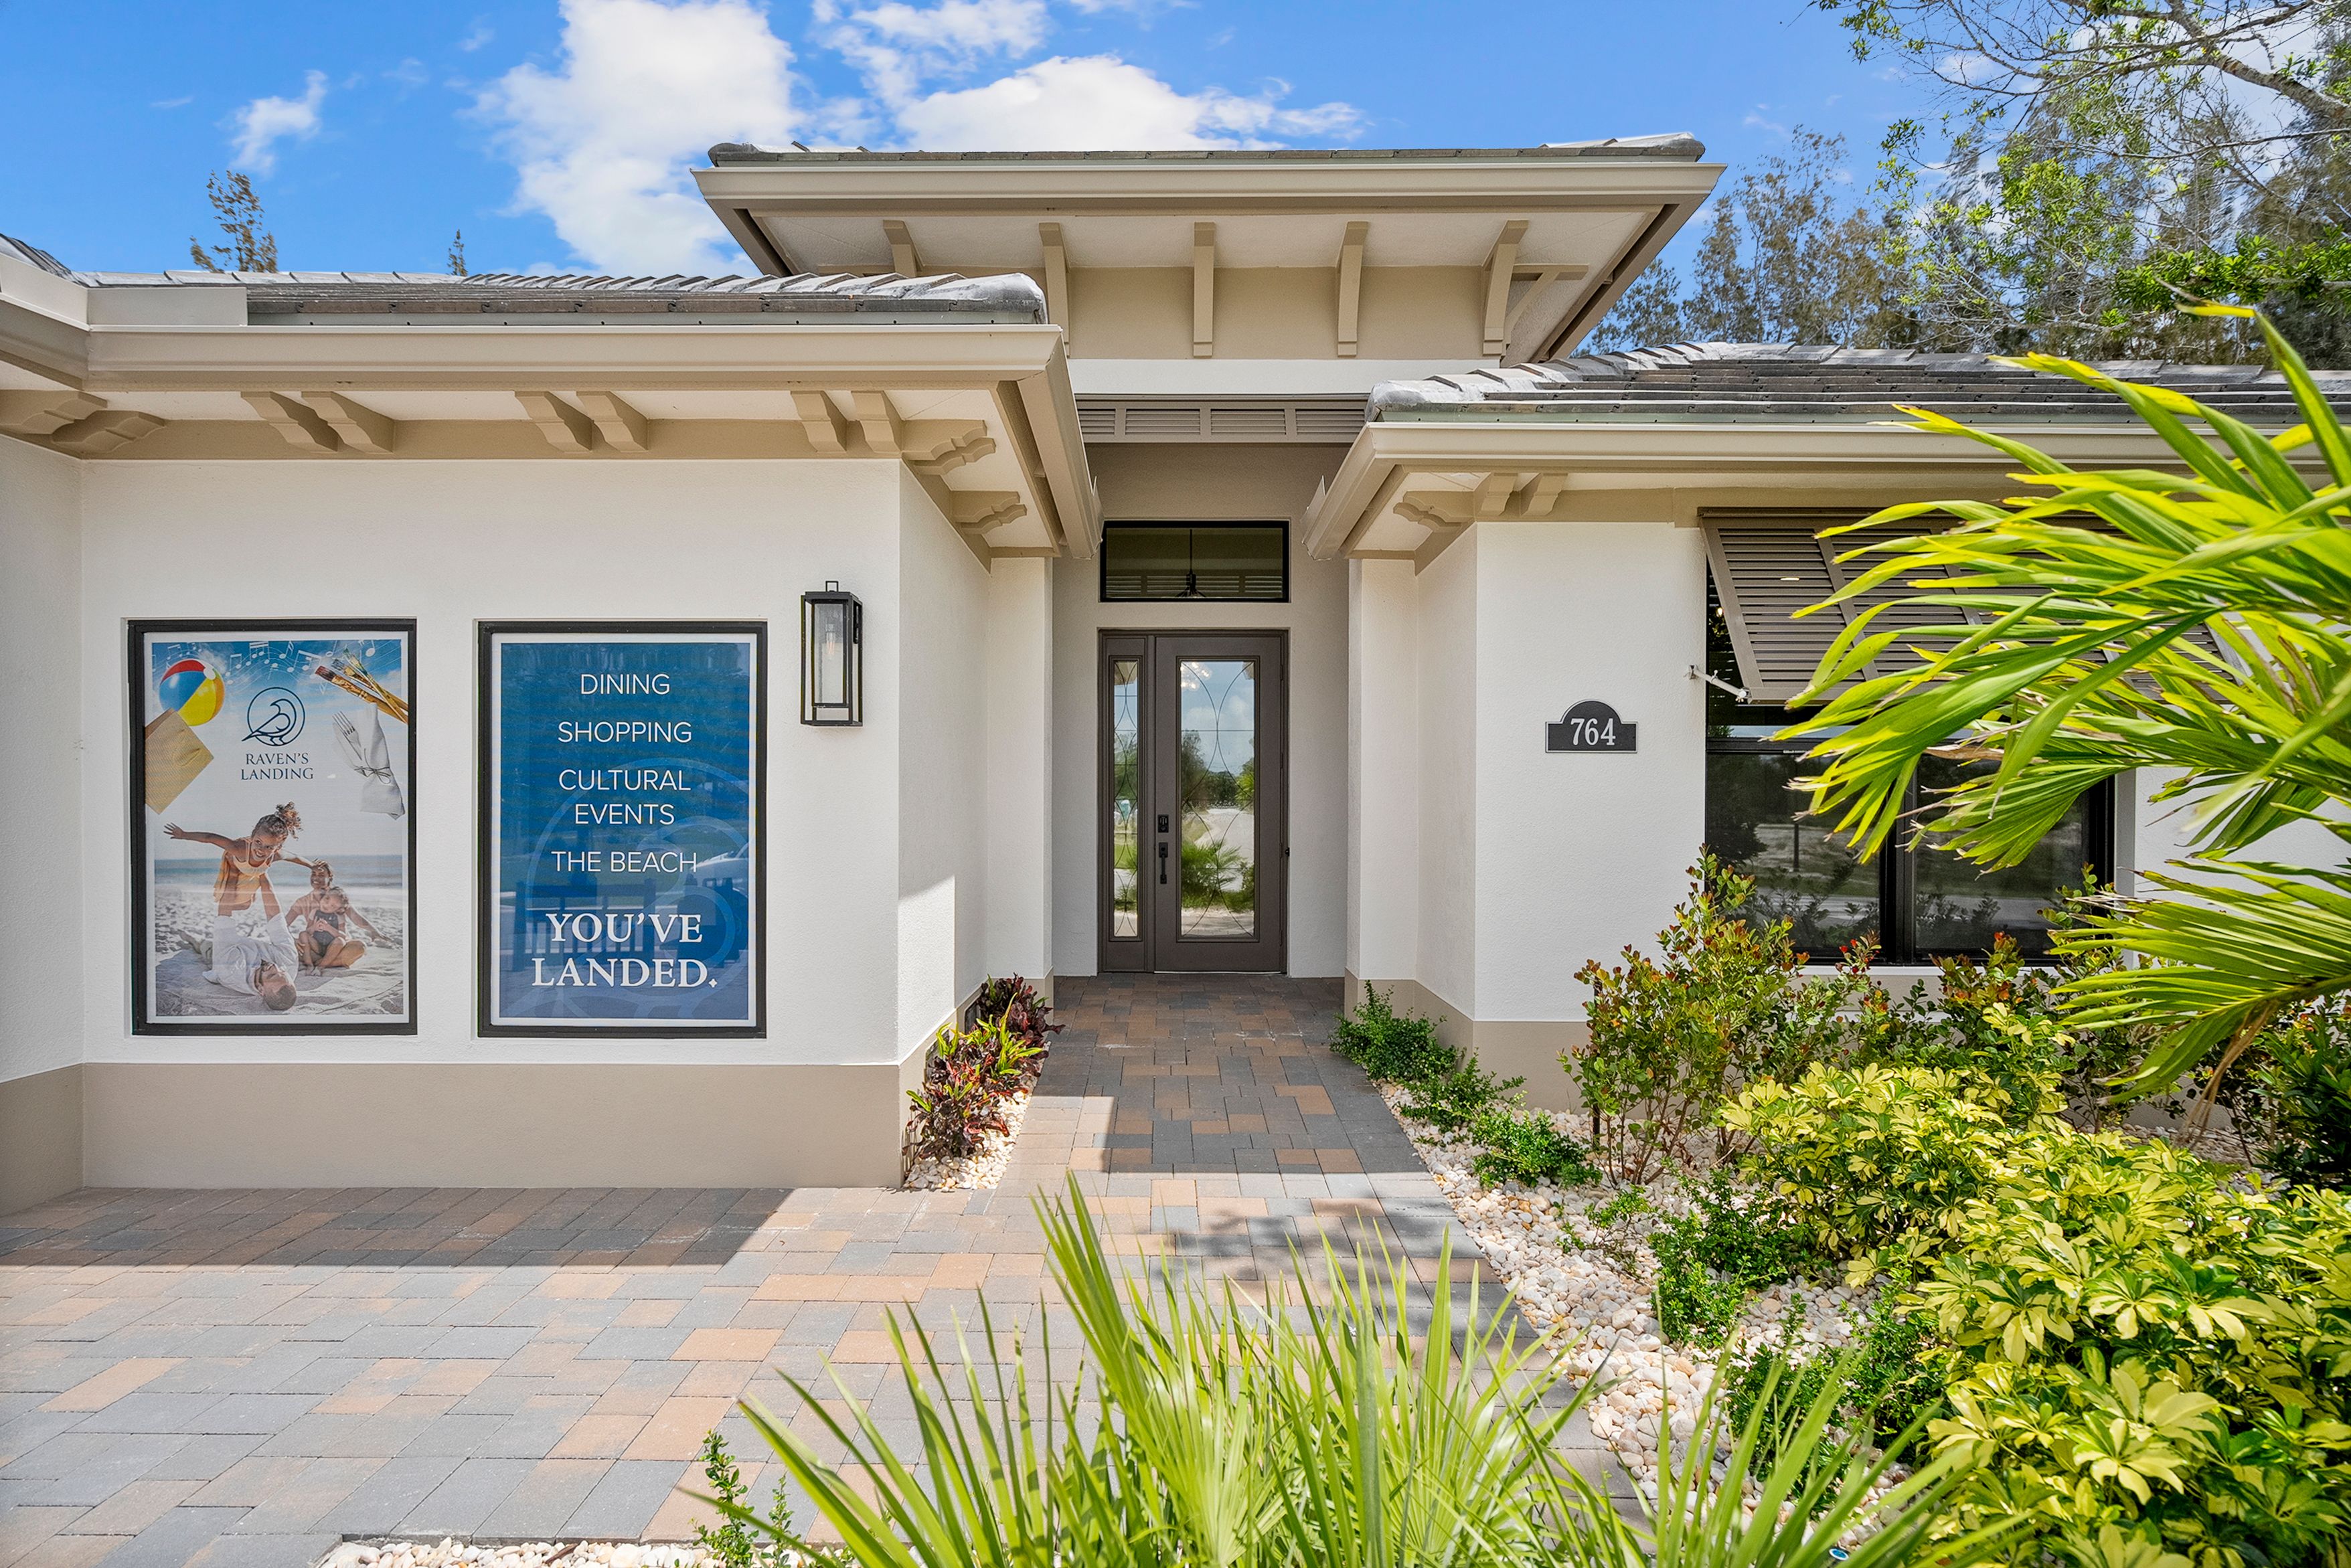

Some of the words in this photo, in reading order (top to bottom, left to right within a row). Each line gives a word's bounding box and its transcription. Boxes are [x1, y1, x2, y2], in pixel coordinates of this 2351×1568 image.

[580, 673, 670, 695] DINING
[558, 721, 692, 743] SHOPPING
[1570, 718, 1616, 746] 764
[246, 752, 309, 766] RAVEN'S
[241, 767, 313, 780] LANDING
[559, 769, 691, 791] CULTURAL
[575, 804, 675, 825] EVENTS
[552, 851, 601, 872] THE
[611, 851, 697, 873] BEACH
[546, 913, 702, 943] YOU'VE
[532, 958, 718, 988] LANDED.
